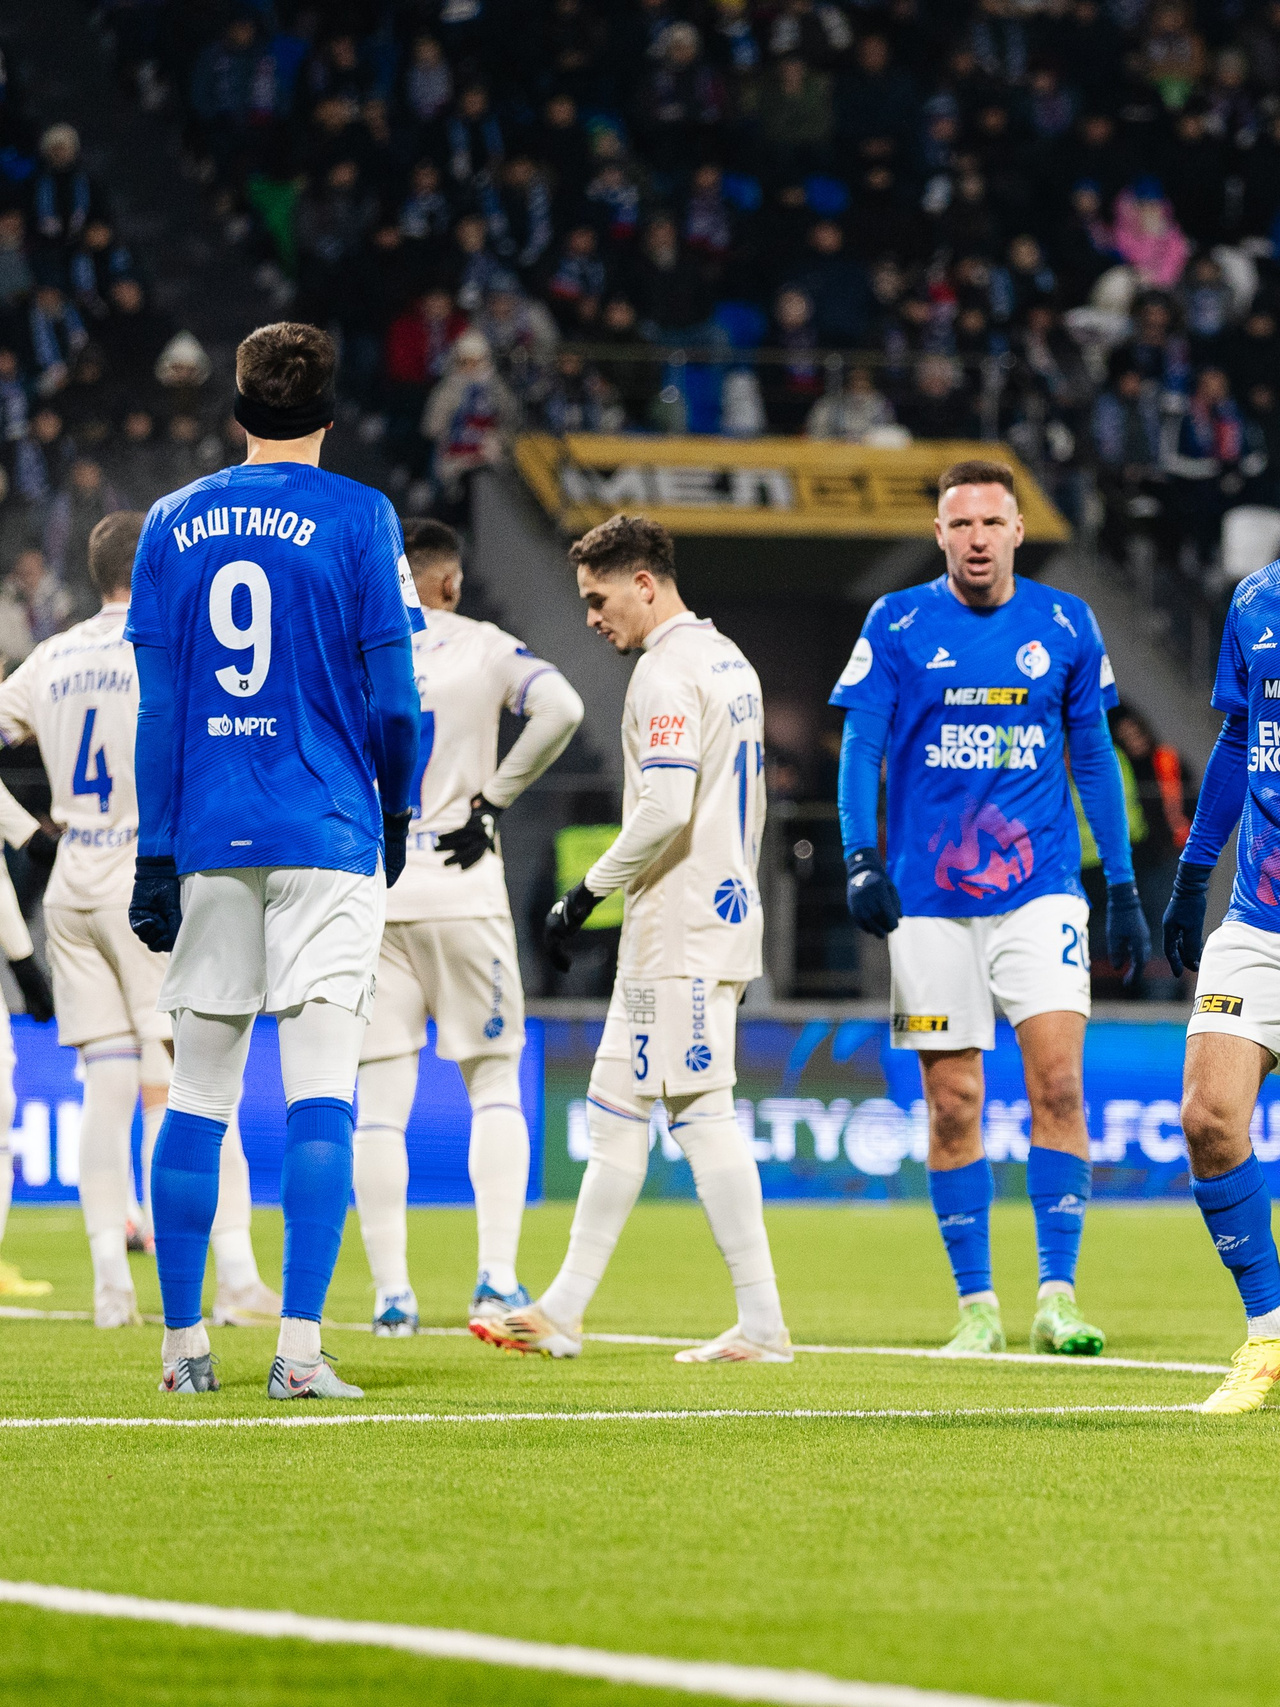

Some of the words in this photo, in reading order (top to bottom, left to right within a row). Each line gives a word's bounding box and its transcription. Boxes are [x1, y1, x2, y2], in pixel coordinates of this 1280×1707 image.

[173, 507, 316, 553] КАШТАНОВ
[209, 560, 272, 698] 9
[944, 687, 1028, 706] МЕЛБЕТ
[235, 717, 277, 737] МРТС
[650, 715, 685, 730] FON
[650, 731, 685, 747] BET
[941, 724, 1046, 748] EKONIVA
[73, 708, 113, 813] 4
[925, 744, 1038, 770] ЭКОНИВА
